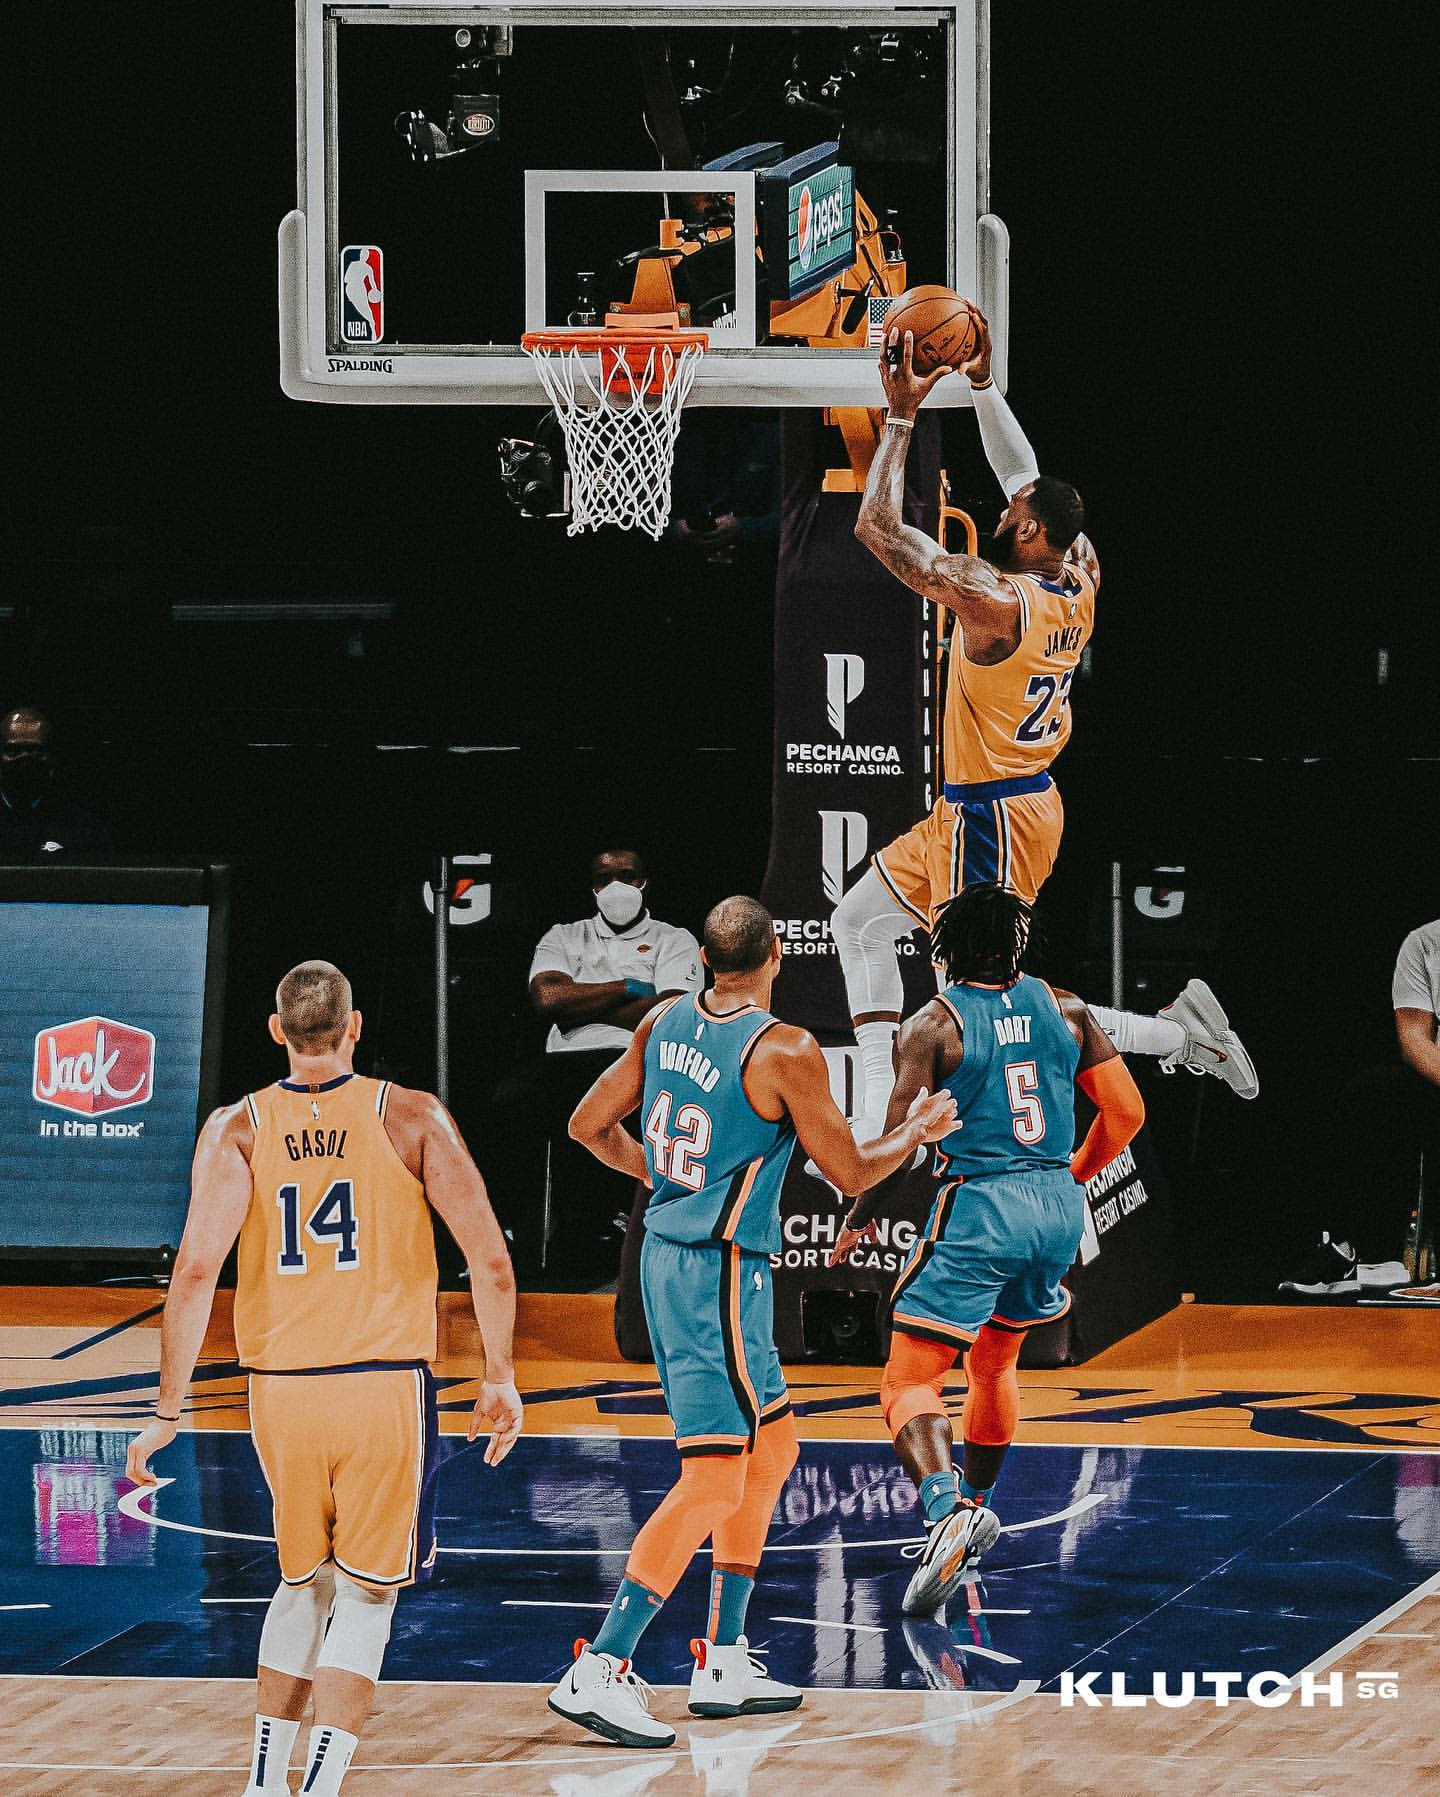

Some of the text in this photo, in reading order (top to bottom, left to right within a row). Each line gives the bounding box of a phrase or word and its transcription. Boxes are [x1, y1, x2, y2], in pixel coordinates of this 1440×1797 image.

[814, 180, 843, 255] pepsi
[347, 321, 368, 337] NBA
[327, 358, 393, 374] SPALDING
[1044, 626, 1083, 658] JAMES
[786, 743, 900, 762] PECHANGA
[786, 762, 901, 776] RESORT CASINO
[782, 942, 837, 955] ESORT
[993, 1015, 1032, 1046] DORT
[40, 1029, 145, 1099] Jack
[659, 1040, 721, 1093] HORFORD
[1005, 1061, 1046, 1145] 5
[40, 1119, 141, 1137] in the box
[645, 1089, 712, 1192] 42
[284, 1129, 347, 1161] GASOL
[276, 1179, 361, 1275] 14
[769, 1249, 834, 1268] SORT
